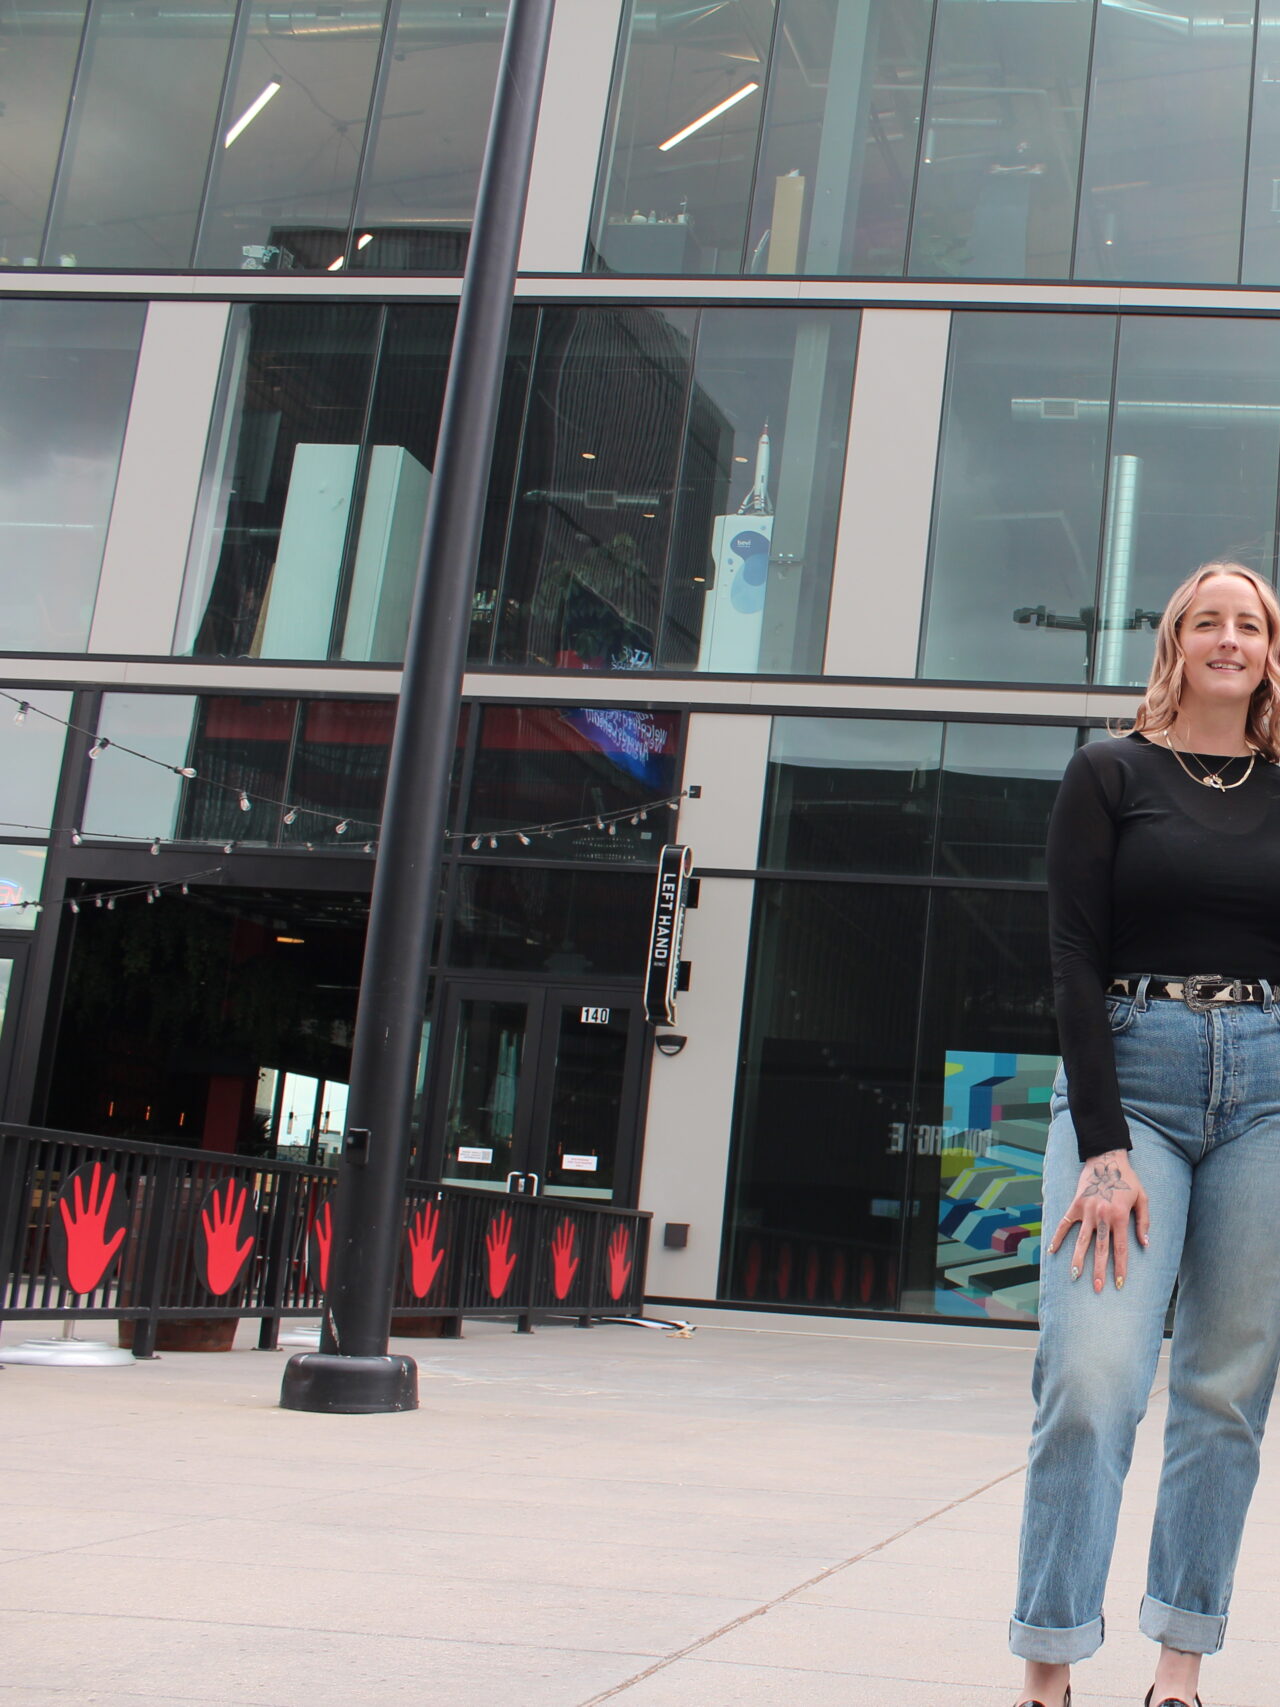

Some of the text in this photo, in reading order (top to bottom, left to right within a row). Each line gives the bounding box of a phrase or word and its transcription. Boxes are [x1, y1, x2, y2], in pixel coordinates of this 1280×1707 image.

[653, 872, 677, 959] LEFT HAND
[584, 1008, 608, 1022] 140
